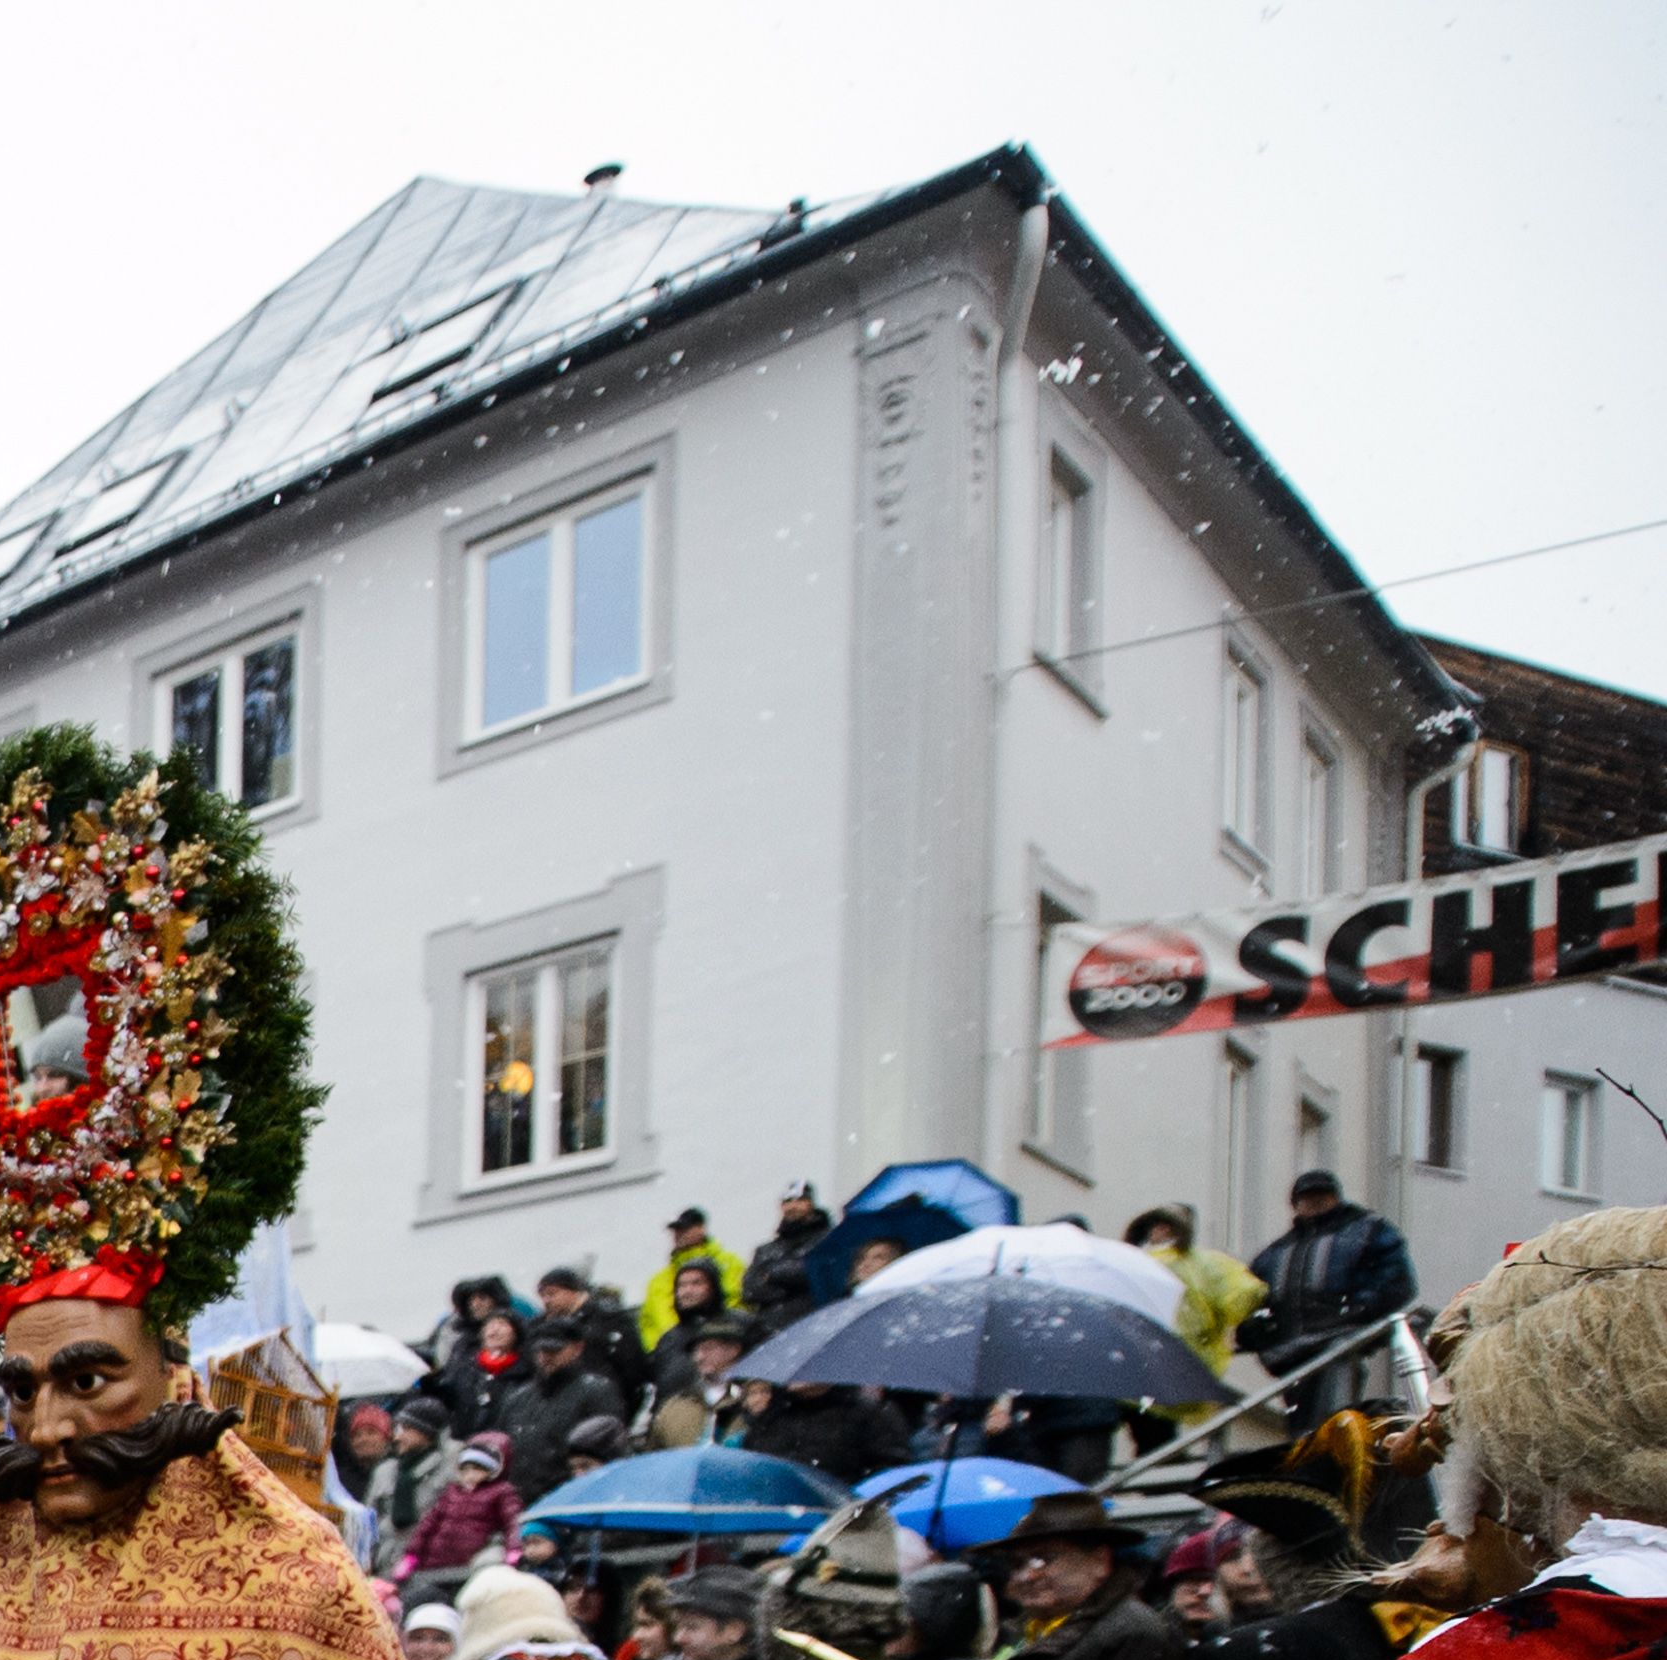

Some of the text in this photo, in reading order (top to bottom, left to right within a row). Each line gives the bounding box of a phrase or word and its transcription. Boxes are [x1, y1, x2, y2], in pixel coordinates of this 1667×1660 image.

[1234, 850, 1667, 1026] SCHE
[1076, 955, 1196, 990] SPORT
[1085, 980, 1187, 1013] 2000
